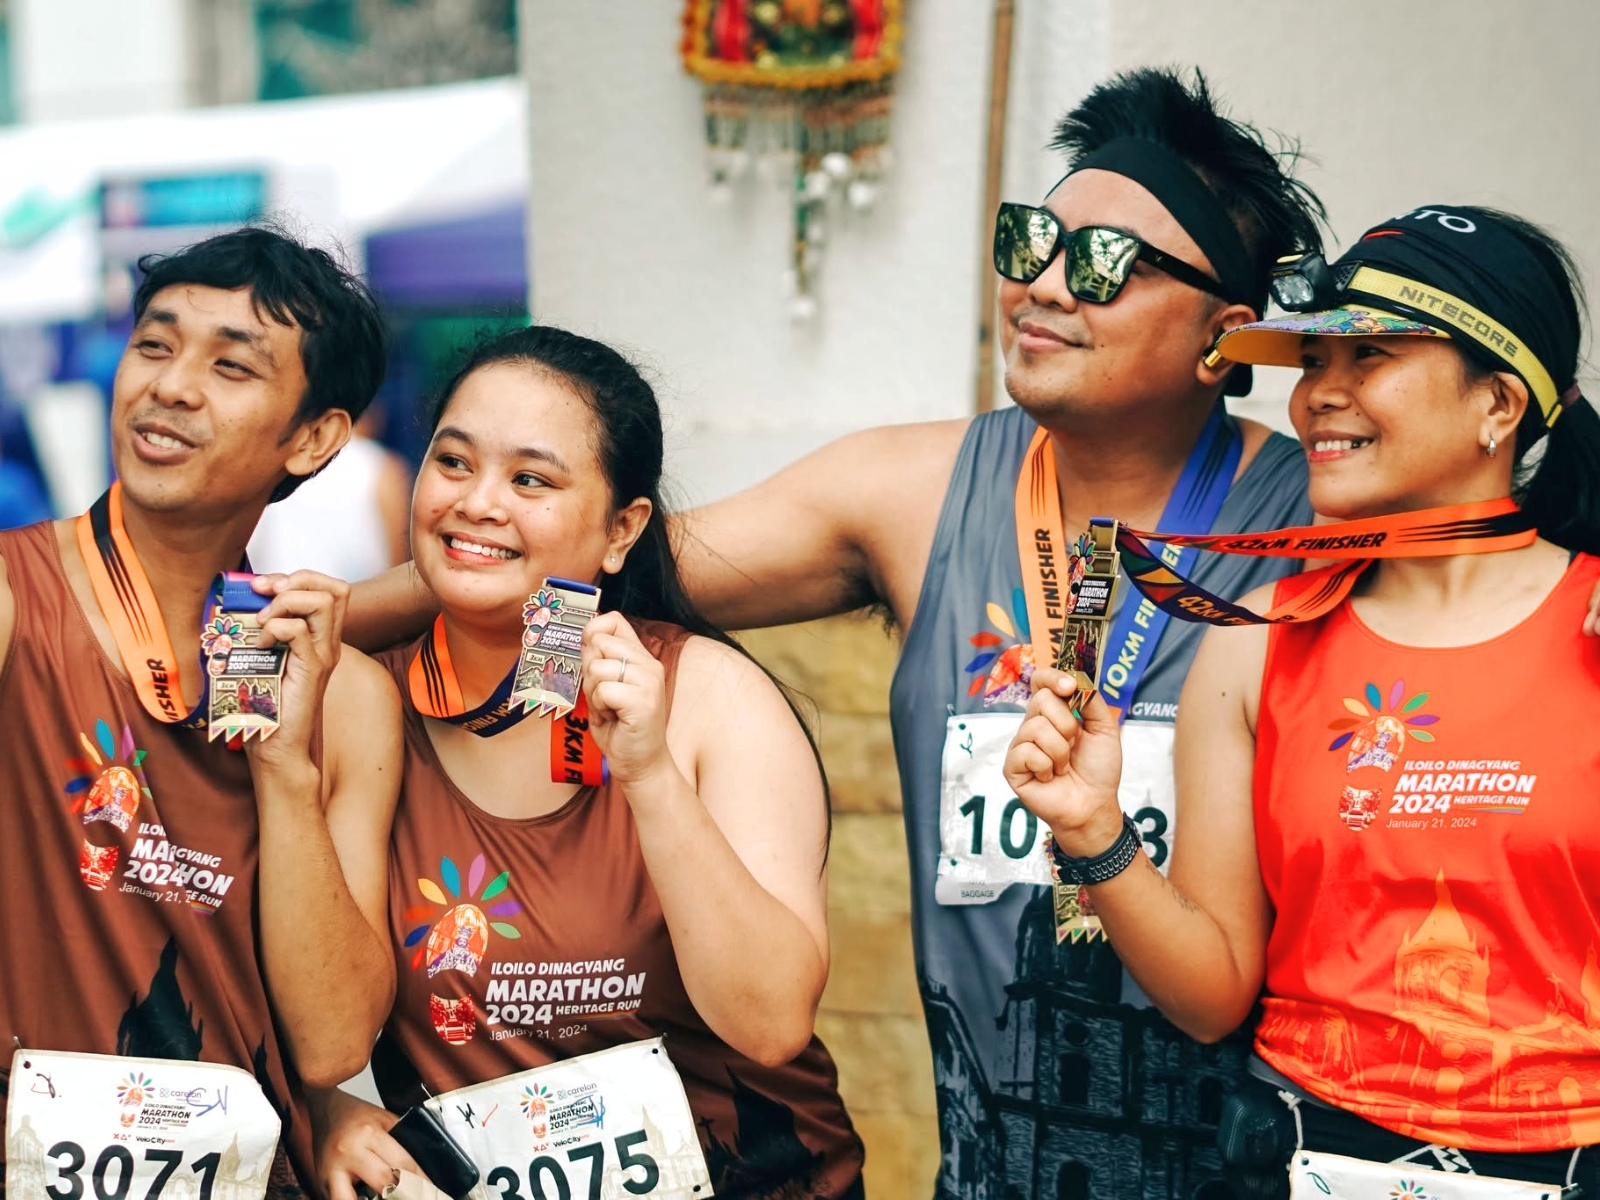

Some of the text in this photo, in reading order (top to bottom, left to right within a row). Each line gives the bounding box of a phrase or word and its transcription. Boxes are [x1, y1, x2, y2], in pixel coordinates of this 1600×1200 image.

[1399, 285, 1518, 359] NITECORE
[1294, 532, 1387, 550] FINISHER
[1034, 527, 1063, 620] FINISHER
[541, 637, 561, 646] 2024
[227, 662, 249, 670] 2024
[228, 655, 277, 663] MARATHON
[1103, 632, 1145, 699] 10KM
[147, 659, 180, 721] ISHER
[1404, 760, 1521, 771] ILOILO DINAGYANG
[1394, 773, 1537, 793] MARATHON
[1388, 794, 1530, 814] 2024 HERITAGE RUN
[1386, 818, 1429, 831] January
[1450, 817, 1477, 829] 2024
[119, 882, 163, 902] January
[123, 860, 183, 887] 2024
[198, 894, 222, 908] RUN
[961, 889, 994, 898] BAGGAGE
[491, 958, 625, 975] ILOILO DINAGYANG
[485, 972, 646, 1002] MARATHON
[486, 999, 642, 1025] 2024 HERITAGE RUN
[489, 1024, 588, 1041] January 21, 2024
[568, 1082, 597, 1096] carelon
[138, 1116, 161, 1125] 2024
[141, 1109, 191, 1118] MARATHON
[549, 1103, 594, 1122] MARATHON
[549, 1118, 570, 1130] 2024
[45, 1141, 221, 1200] 3071
[487, 1129, 659, 1200] 3075
